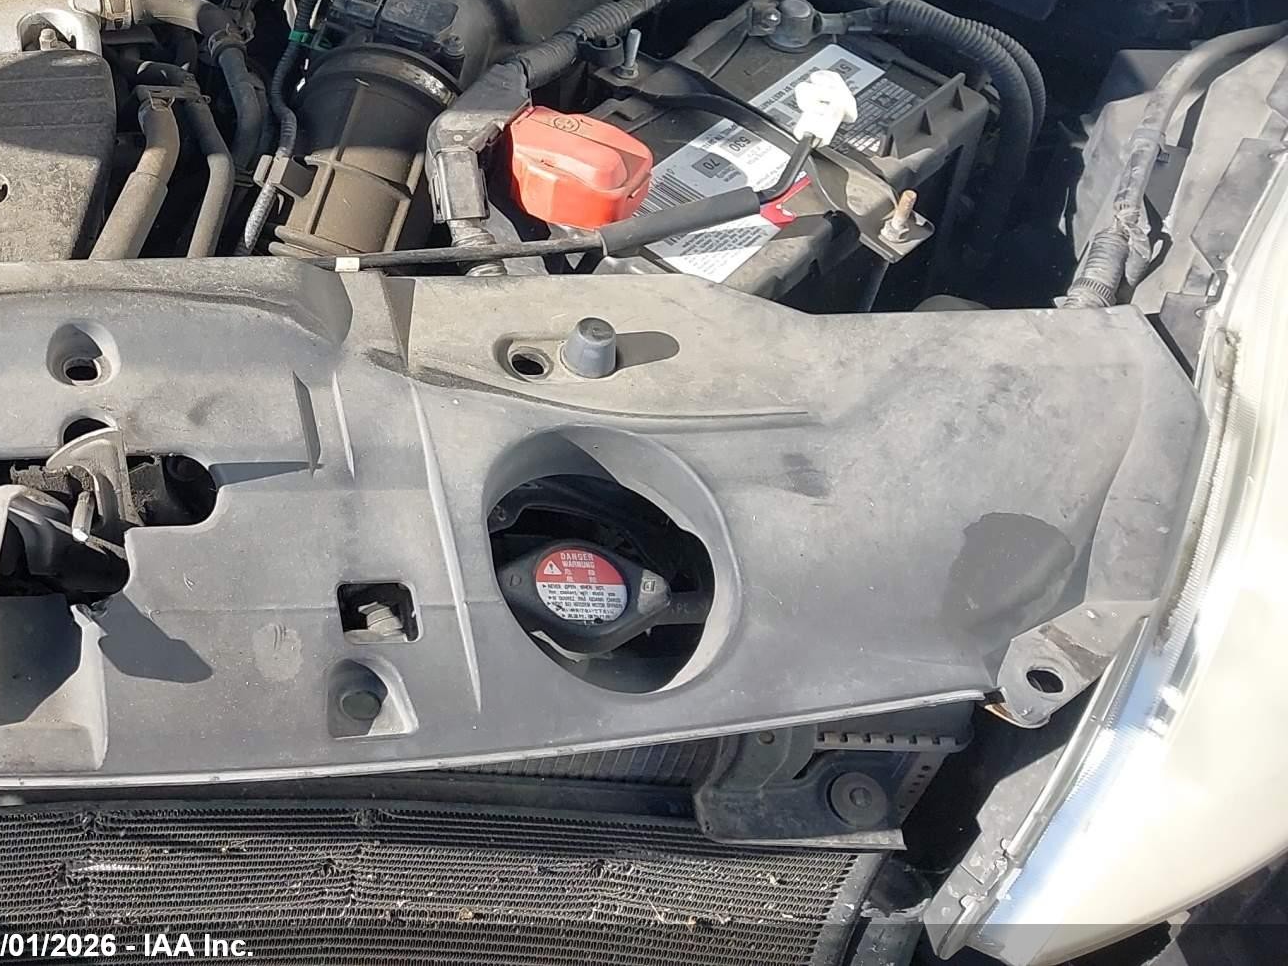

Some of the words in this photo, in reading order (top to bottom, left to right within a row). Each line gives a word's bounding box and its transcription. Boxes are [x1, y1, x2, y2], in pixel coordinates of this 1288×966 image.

[728, 136, 752, 152] 530
[702, 159, 721, 170] 70
[559, 552, 594, 561] DANGER
[562, 560, 595, 568] WARNING
